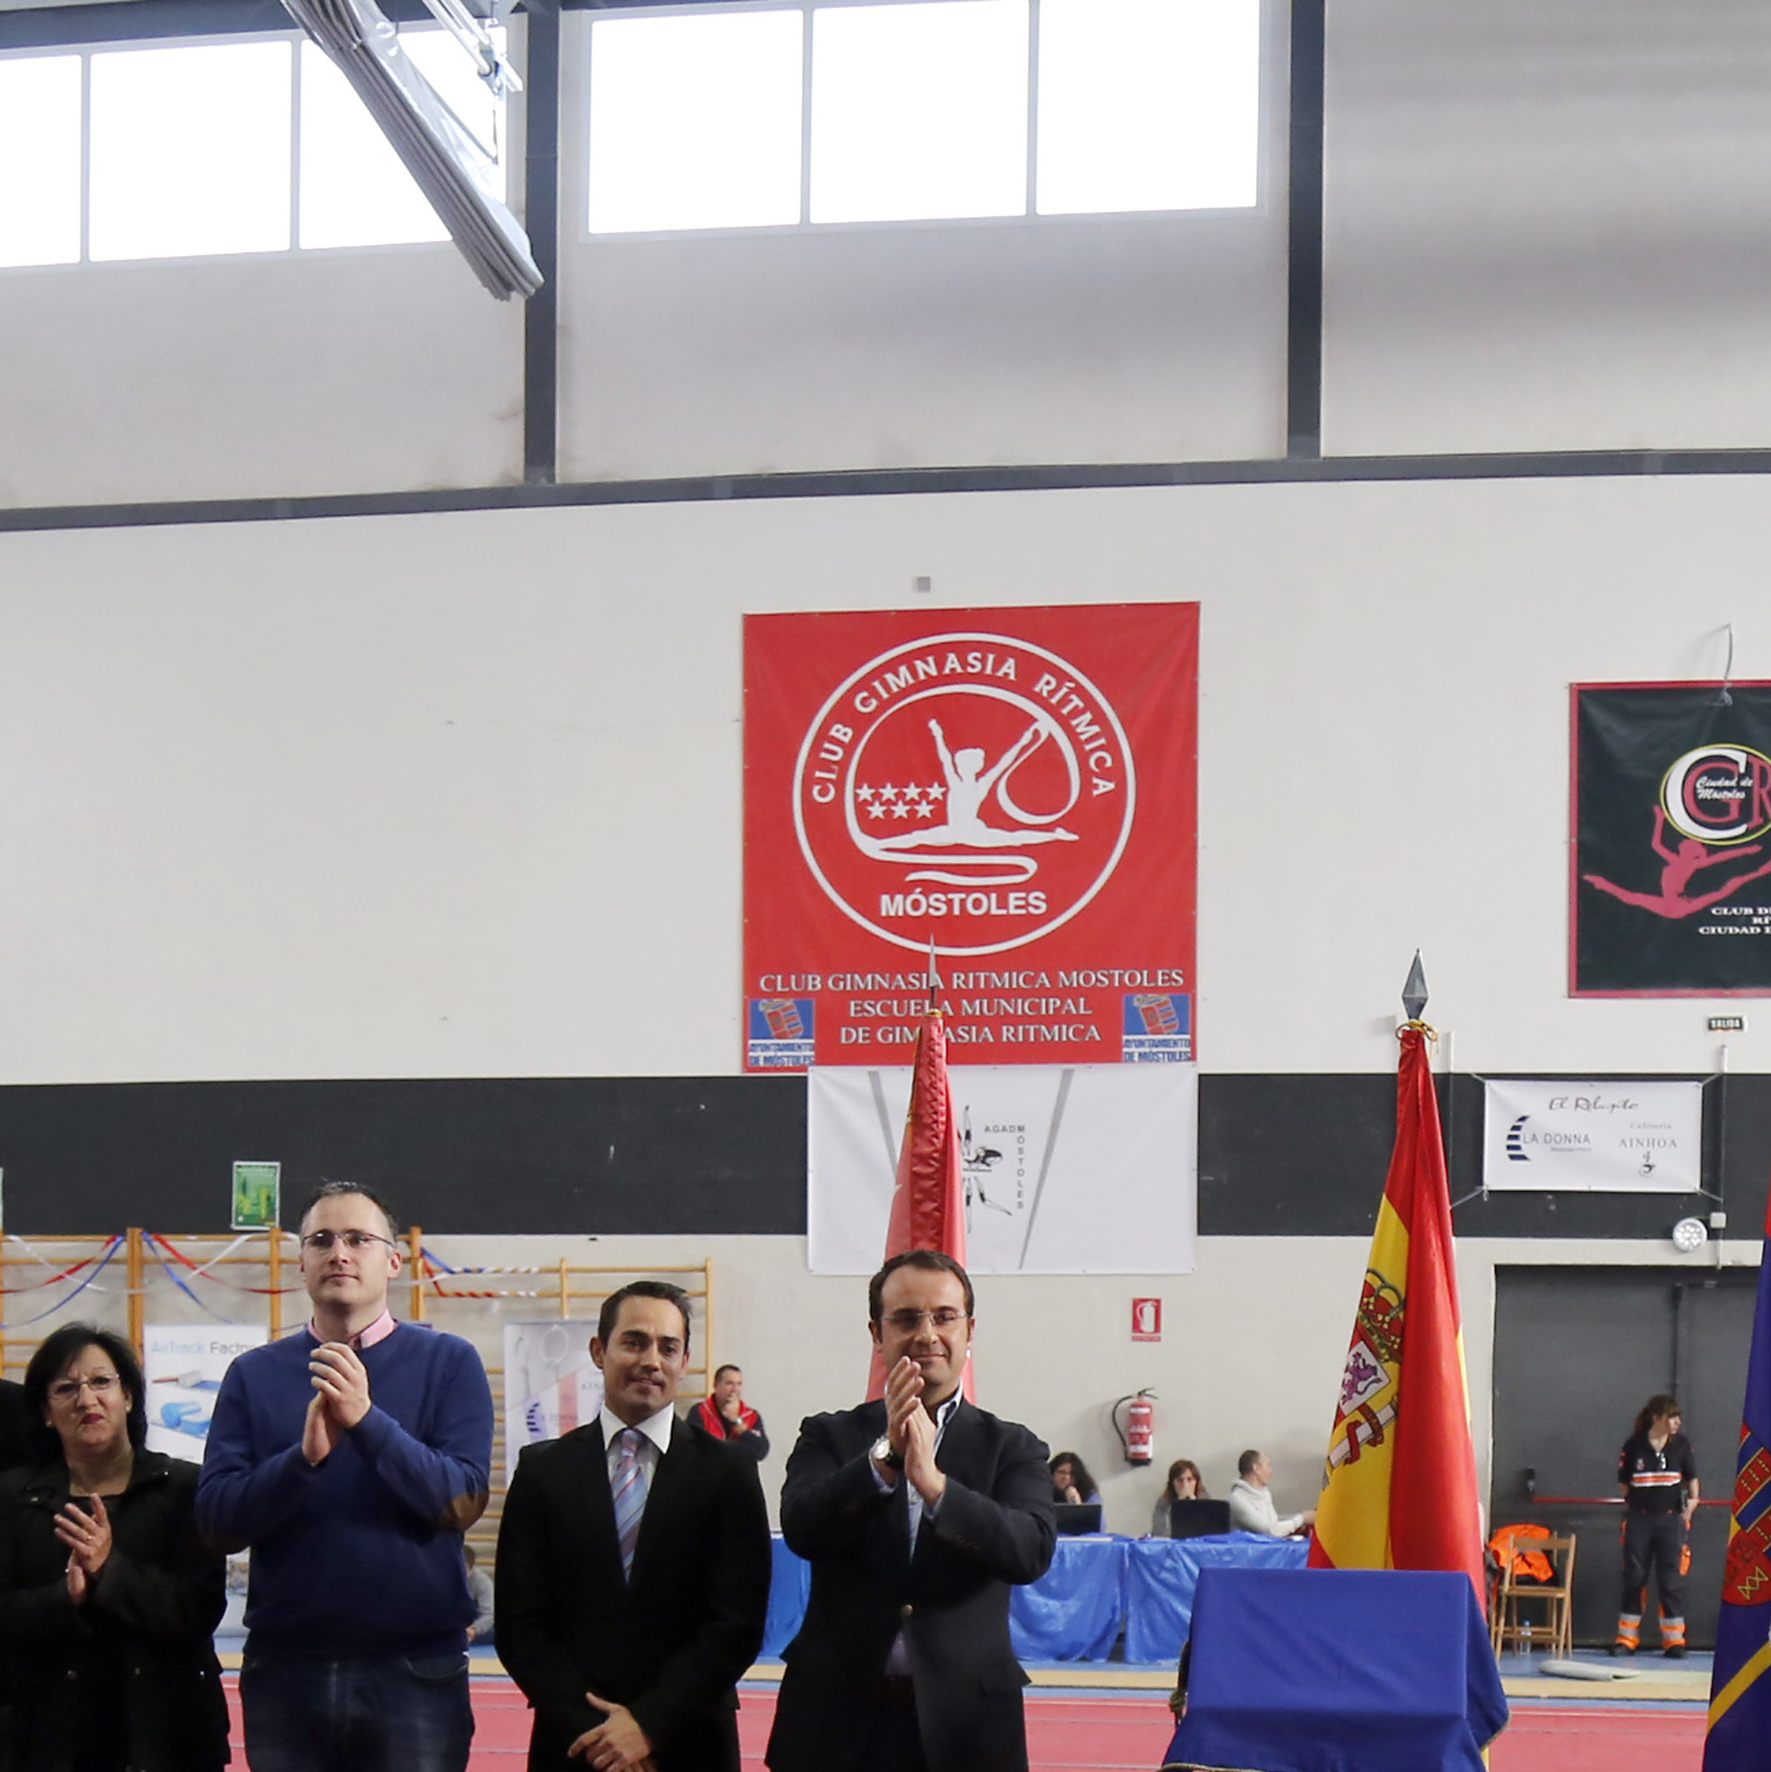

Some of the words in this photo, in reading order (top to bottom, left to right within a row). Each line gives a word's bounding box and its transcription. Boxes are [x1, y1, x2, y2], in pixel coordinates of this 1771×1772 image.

[812, 723, 854, 803] CLUB
[854, 652, 1018, 713] GIMNASIA
[1033, 673, 1116, 797] RÍTMICA
[1696, 776, 1738, 788] Ciudad
[1740, 777, 1753, 787] de
[880, 888, 1047, 917] MÓSTOLES
[1711, 907, 1754, 915] CLUB
[1698, 926, 1760, 934] CIUDAD
[759, 973, 822, 992] CLUB
[828, 971, 945, 991] GIMNASIA
[952, 970, 1051, 990] RITMICA
[1058, 969, 1185, 988] MOSTOLES
[961, 997, 1093, 1017] MUNICIPAL
[840, 1027, 871, 1044] DE
[876, 1025, 995, 1044] GIMASIA
[1001, 1024, 1101, 1043] RITMICA
[1544, 1133, 1591, 1144] DONNA
[1619, 1138, 1677, 1148] AINHOA
